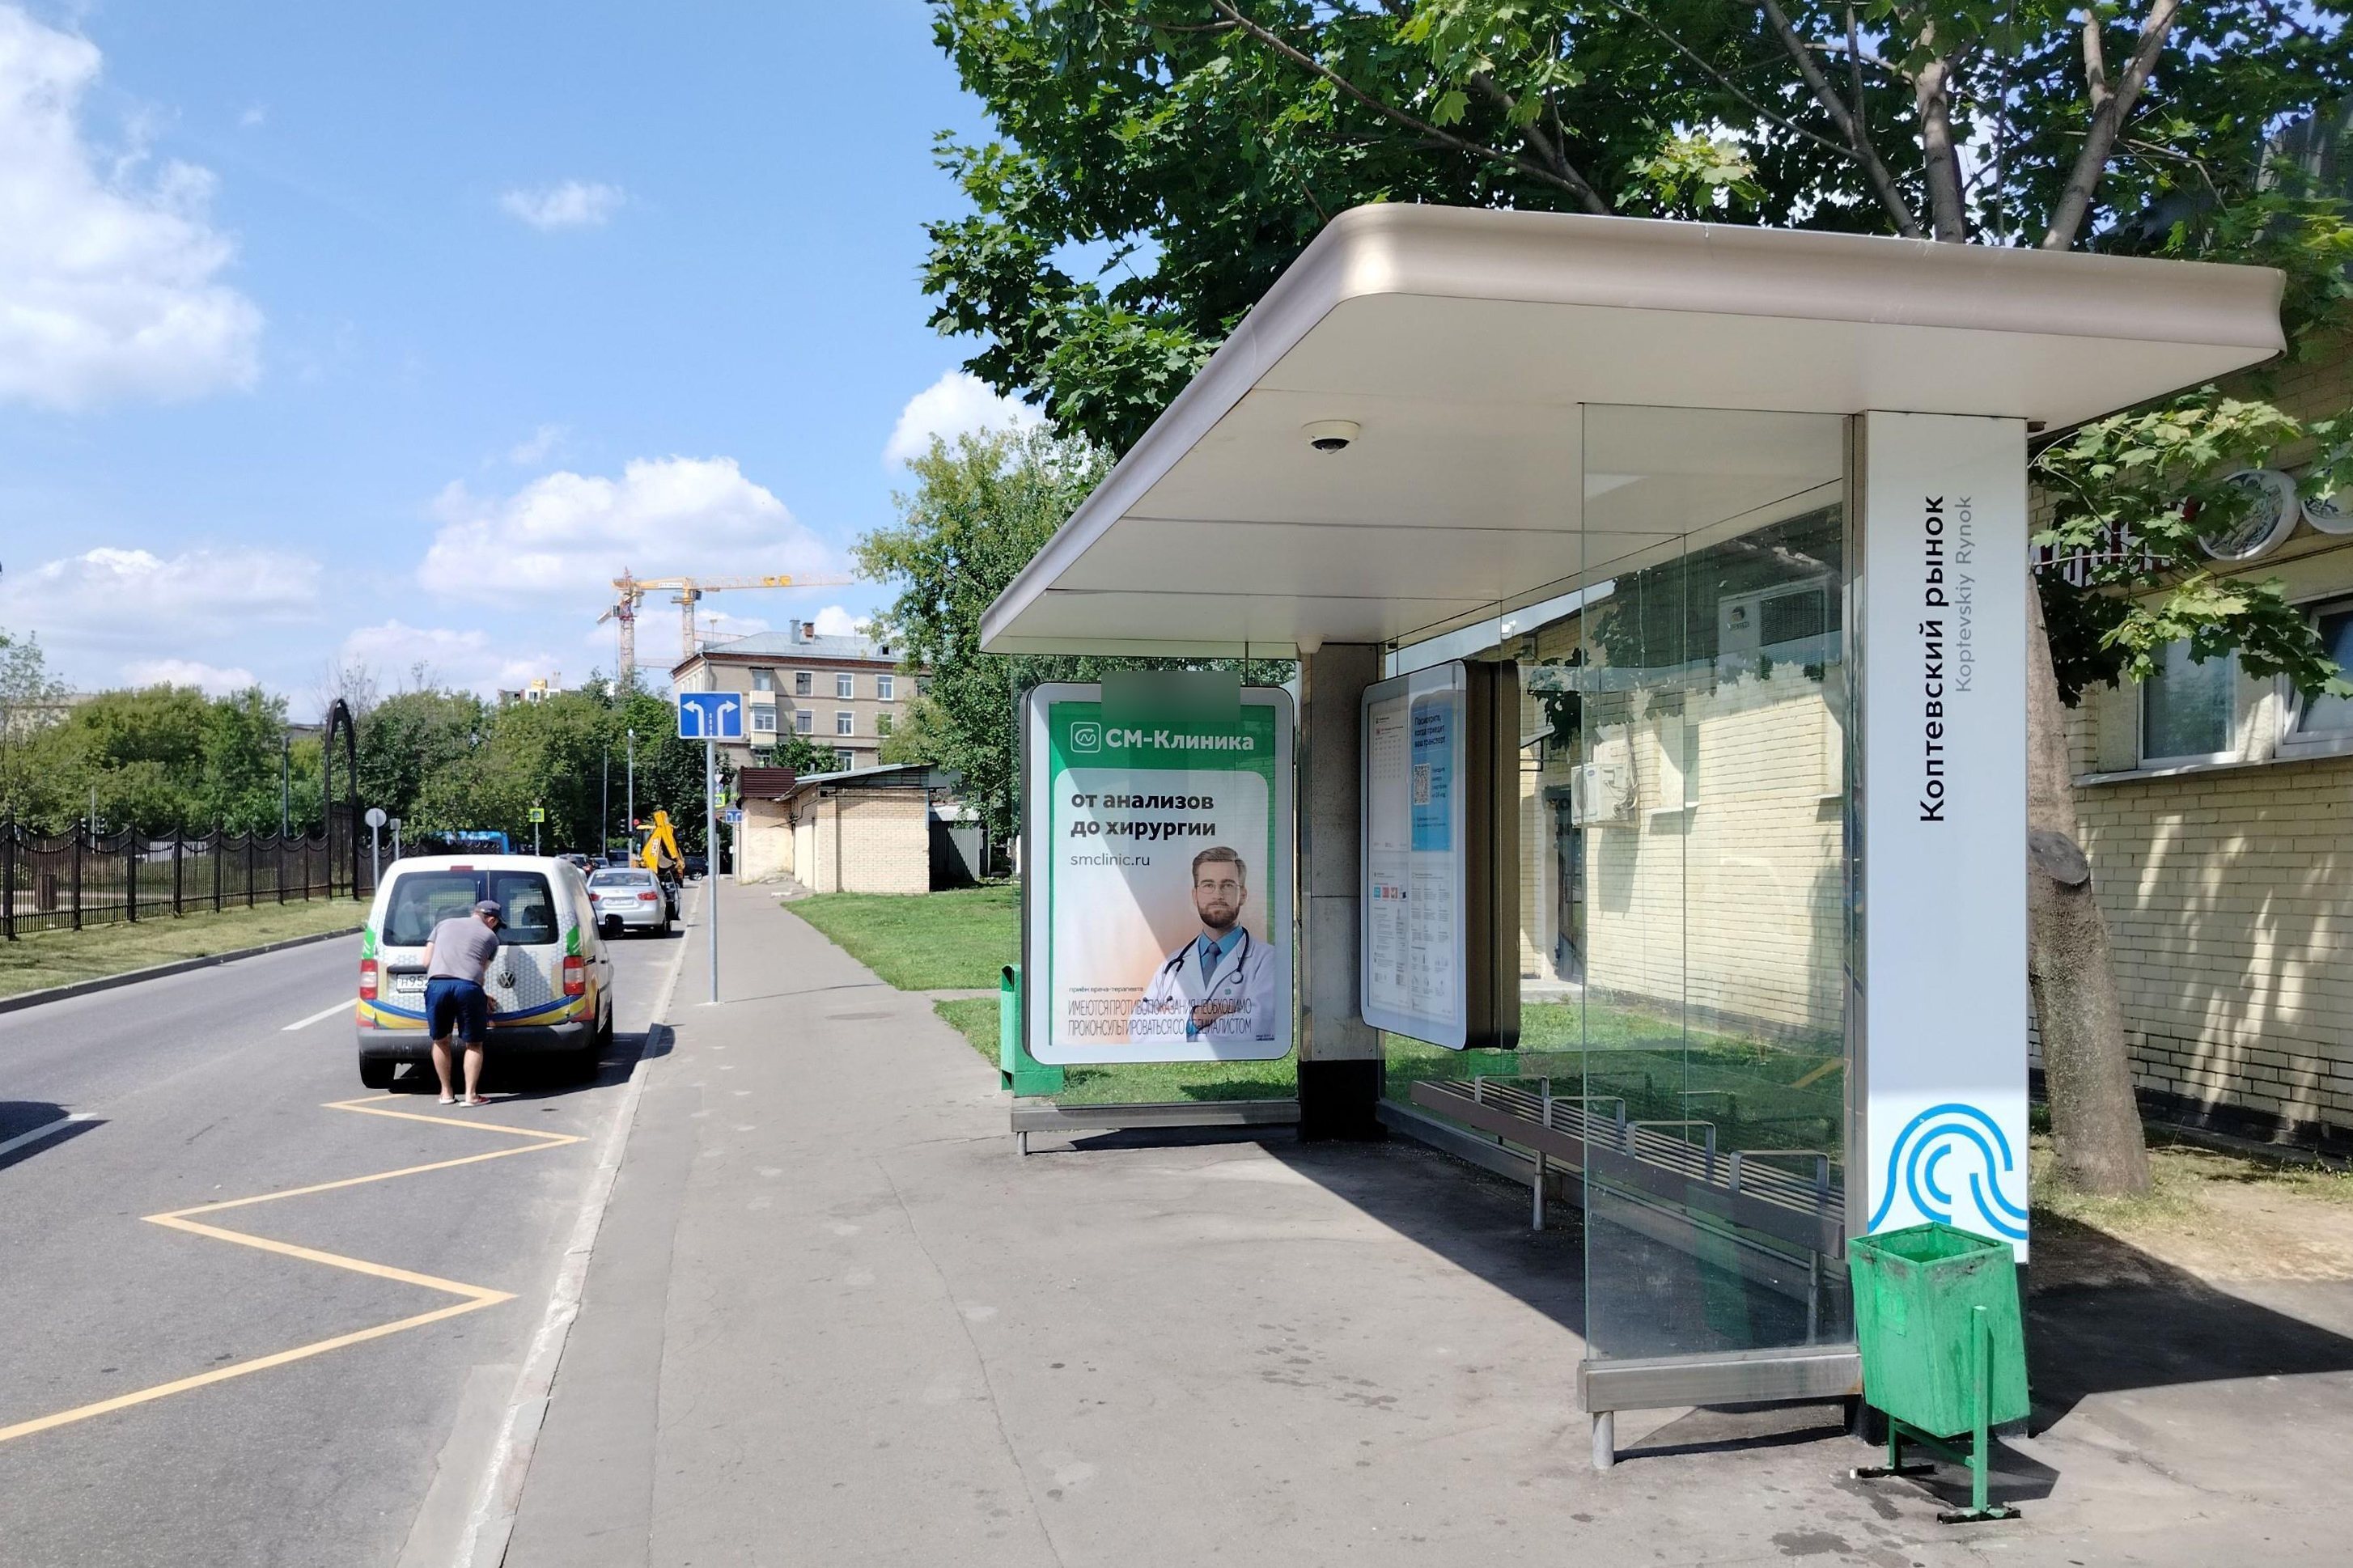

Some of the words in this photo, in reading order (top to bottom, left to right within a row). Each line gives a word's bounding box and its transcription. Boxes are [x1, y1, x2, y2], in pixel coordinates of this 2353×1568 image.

[1954, 496, 1975, 564] Rynok
[1925, 495, 1949, 607] рынок
[1955, 573, 1975, 692] Koptevskiy
[1918, 621, 1944, 821] Коптевский
[1105, 728, 1255, 751] СМ-Клиника
[1071, 794, 1098, 808] от
[1102, 795, 1215, 810] анализов
[1070, 820, 1100, 838] до
[1105, 821, 1216, 841] хирургии
[651, 838, 659, 858] JCB
[1070, 852, 1151, 867] smclinic.ru
[1067, 998, 1109, 1016] ИМЕЮТСЯ
[1109, 998, 1196, 1016] ПРОТИВОПОКАЗАНИЯ
[1067, 1019, 1172, 1036] ПРОКОНСУЛЬТИРОВАТЬСЯ
[1172, 1019, 1185, 1036] СО
